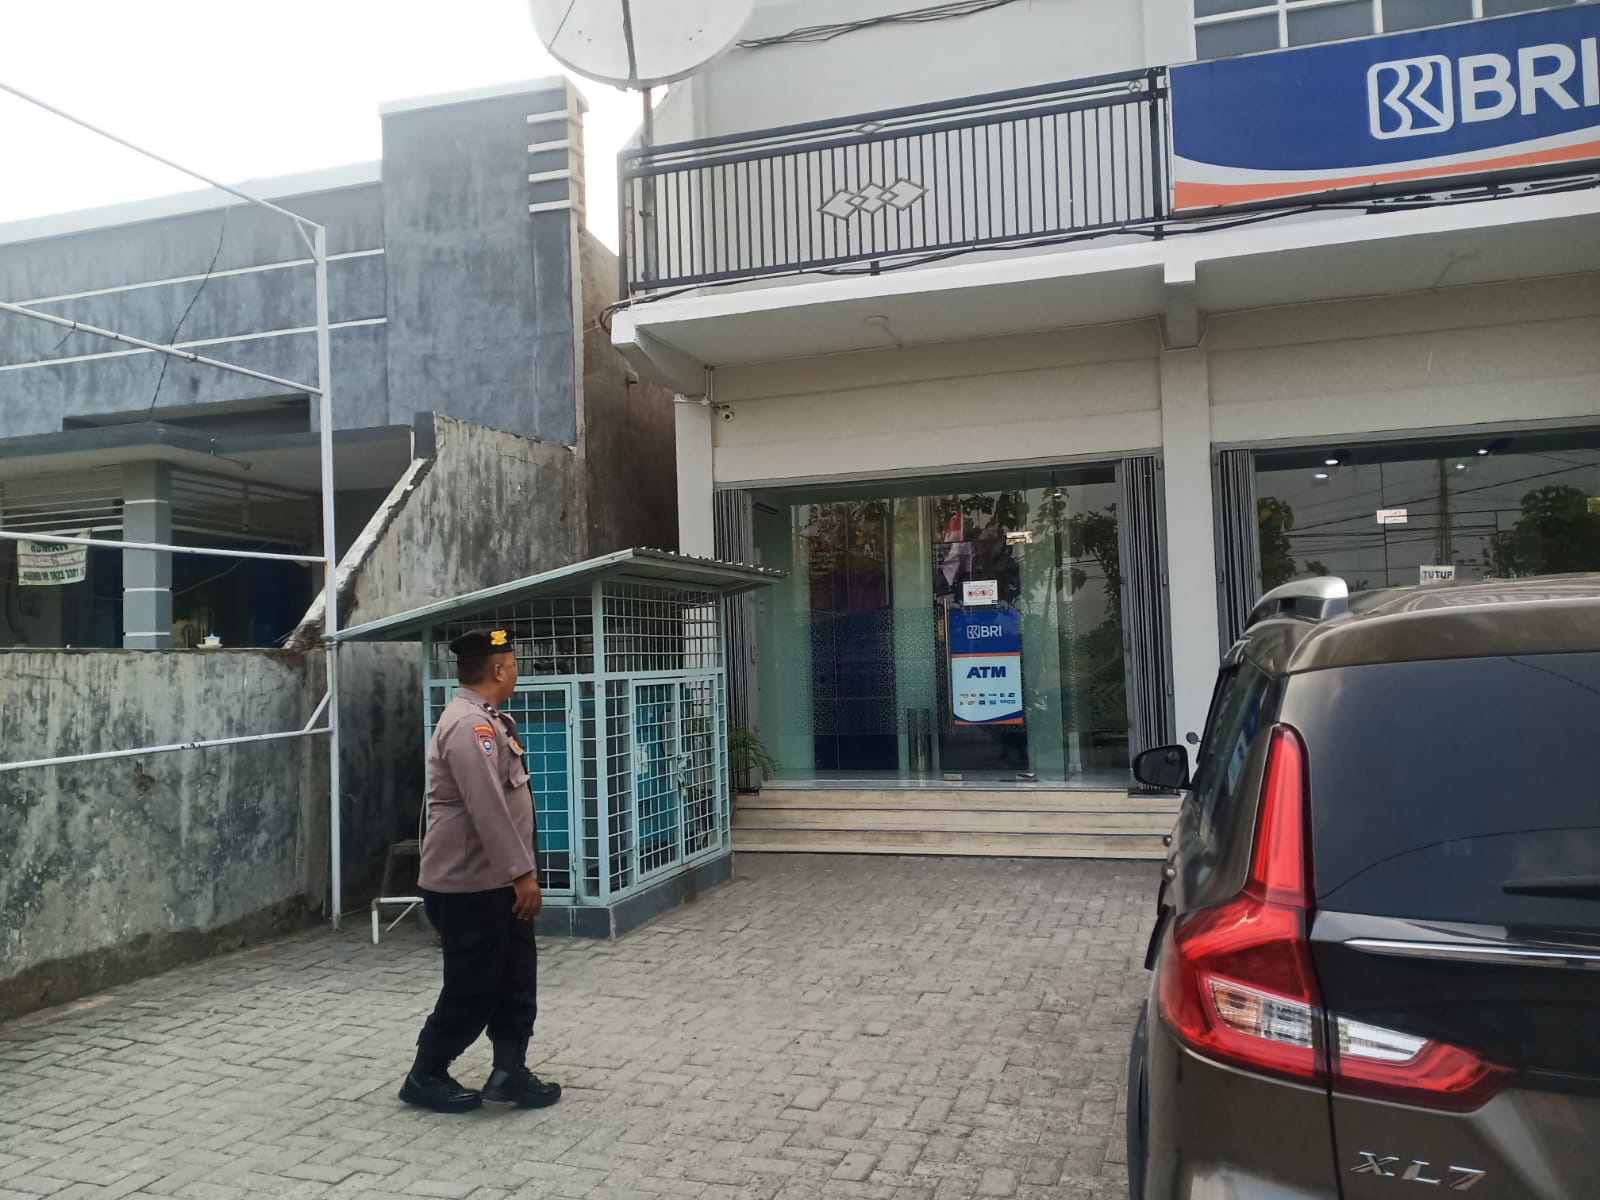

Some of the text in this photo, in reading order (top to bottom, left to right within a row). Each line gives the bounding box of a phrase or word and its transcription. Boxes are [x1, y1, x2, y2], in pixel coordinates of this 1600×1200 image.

[1458, 37, 1600, 124] BRI
[1422, 570, 1453, 579] TUTUP
[980, 625, 1002, 638] BRI
[966, 666, 1007, 679] ATM
[1349, 1151, 1488, 1192] XL7
